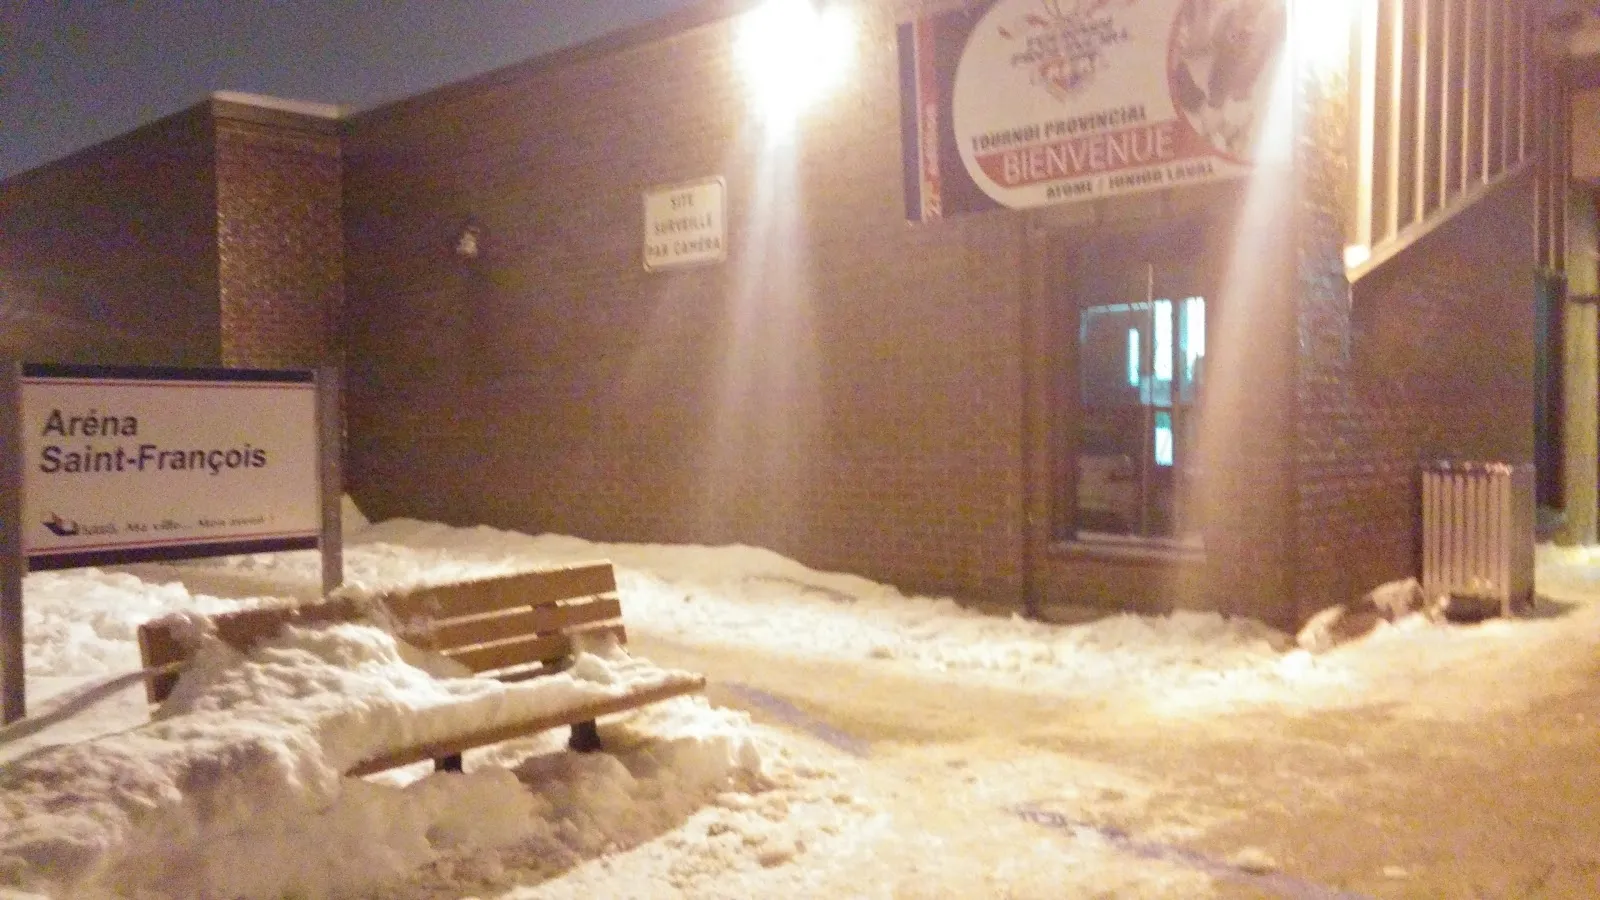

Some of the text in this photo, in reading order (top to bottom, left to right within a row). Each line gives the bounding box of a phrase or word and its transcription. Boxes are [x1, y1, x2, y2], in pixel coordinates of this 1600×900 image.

[1003, 123, 1177, 185] BIENVENUE
[42, 408, 138, 438] Aréna
[41, 443, 267, 475] Saint-François
